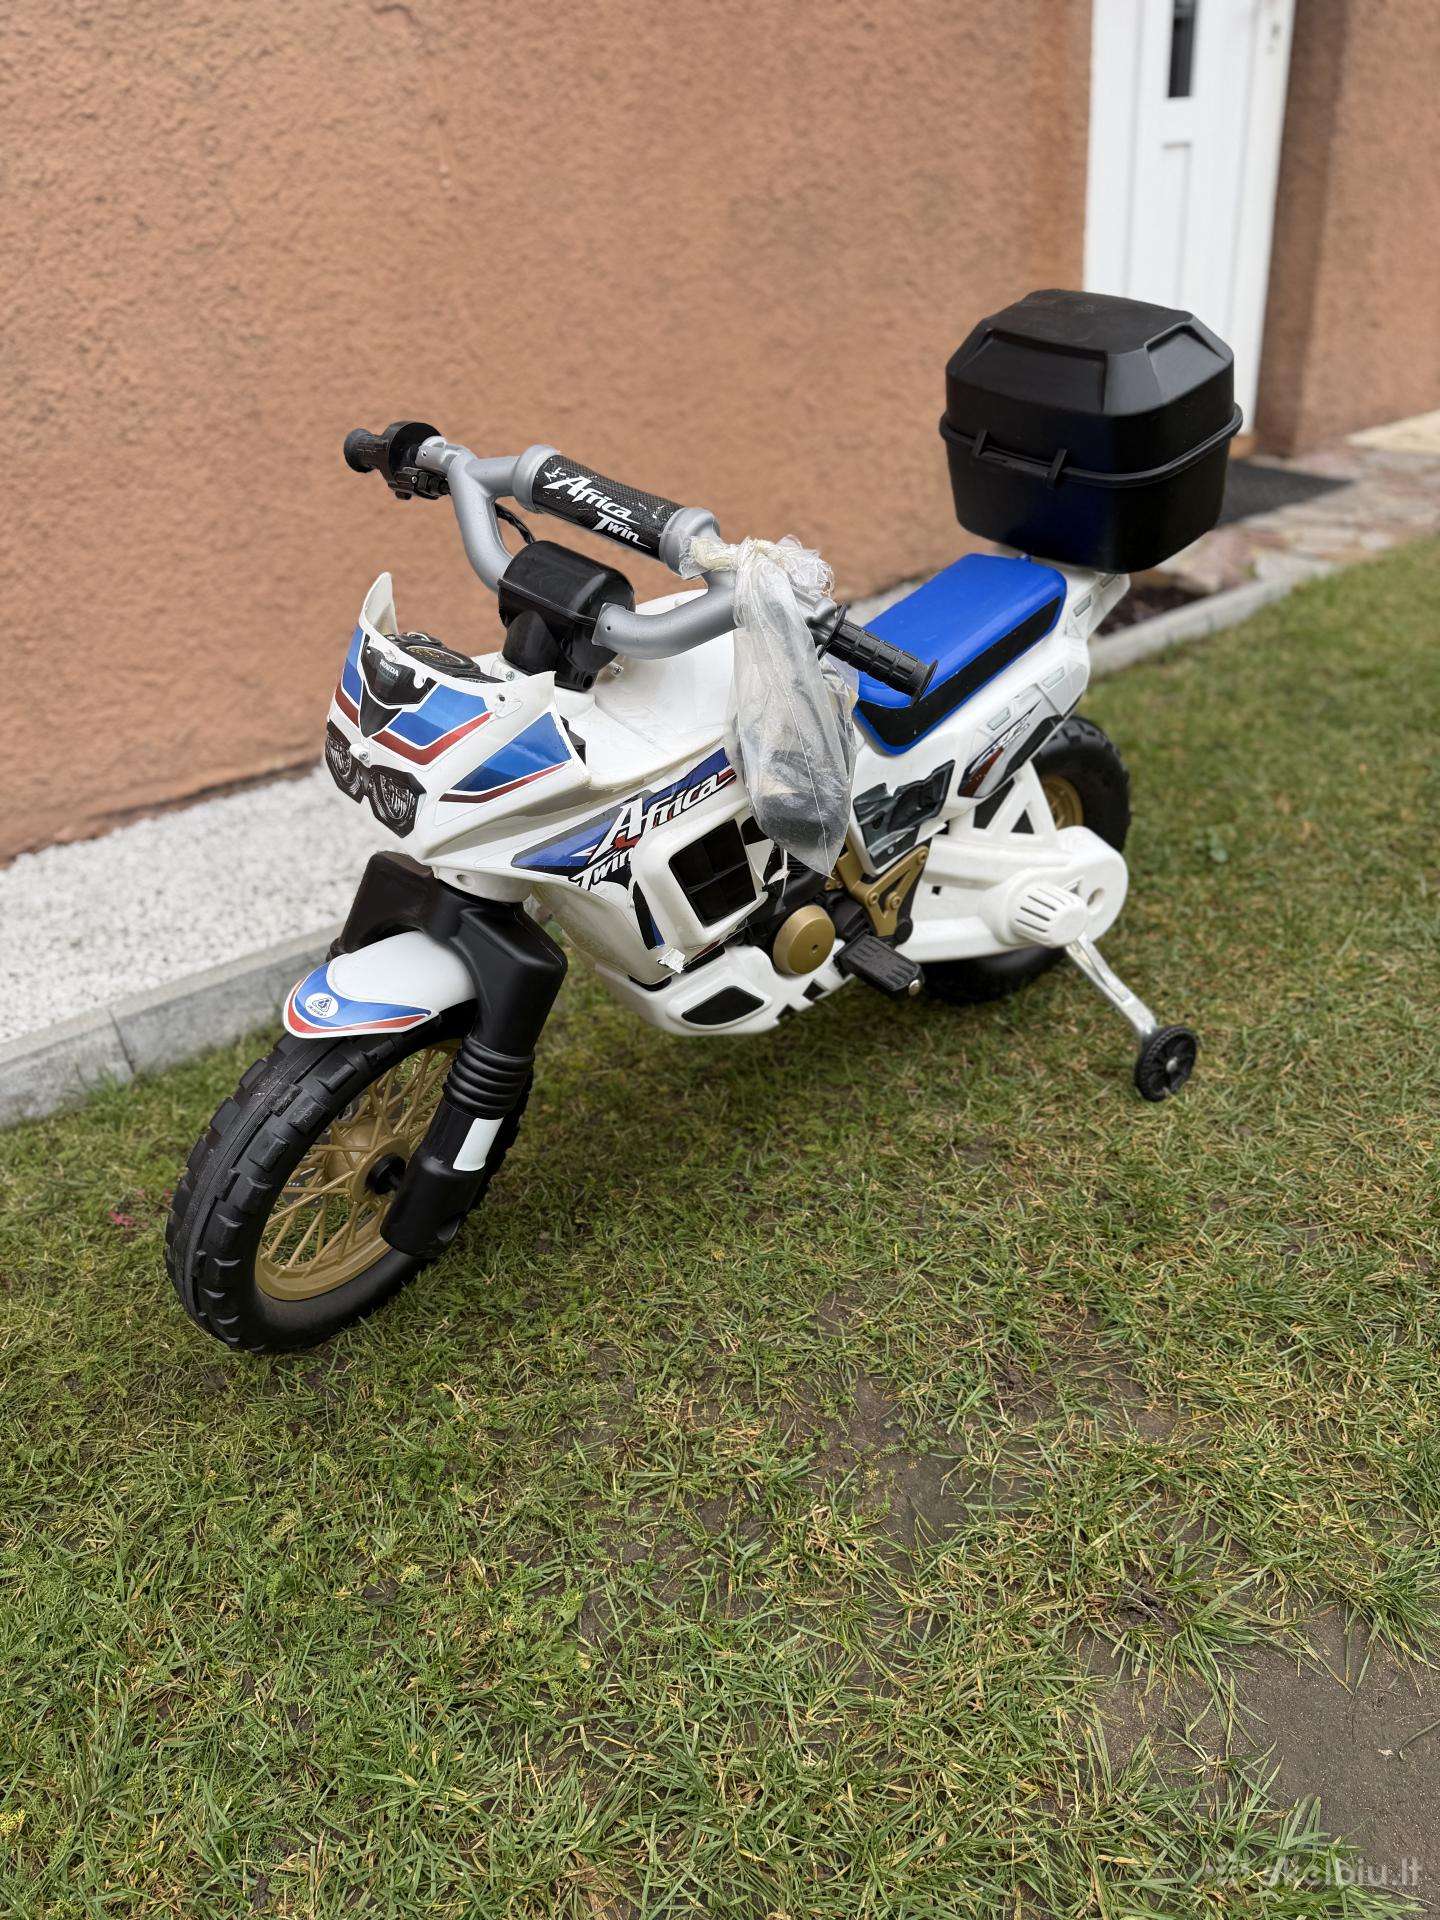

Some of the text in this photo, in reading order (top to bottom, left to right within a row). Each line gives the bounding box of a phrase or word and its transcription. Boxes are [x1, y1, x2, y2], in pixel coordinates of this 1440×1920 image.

[543, 475, 641, 525] Africa
[592, 511, 652, 549] Twin
[379, 658, 399, 677] HONDA
[586, 772, 737, 865] Africa
